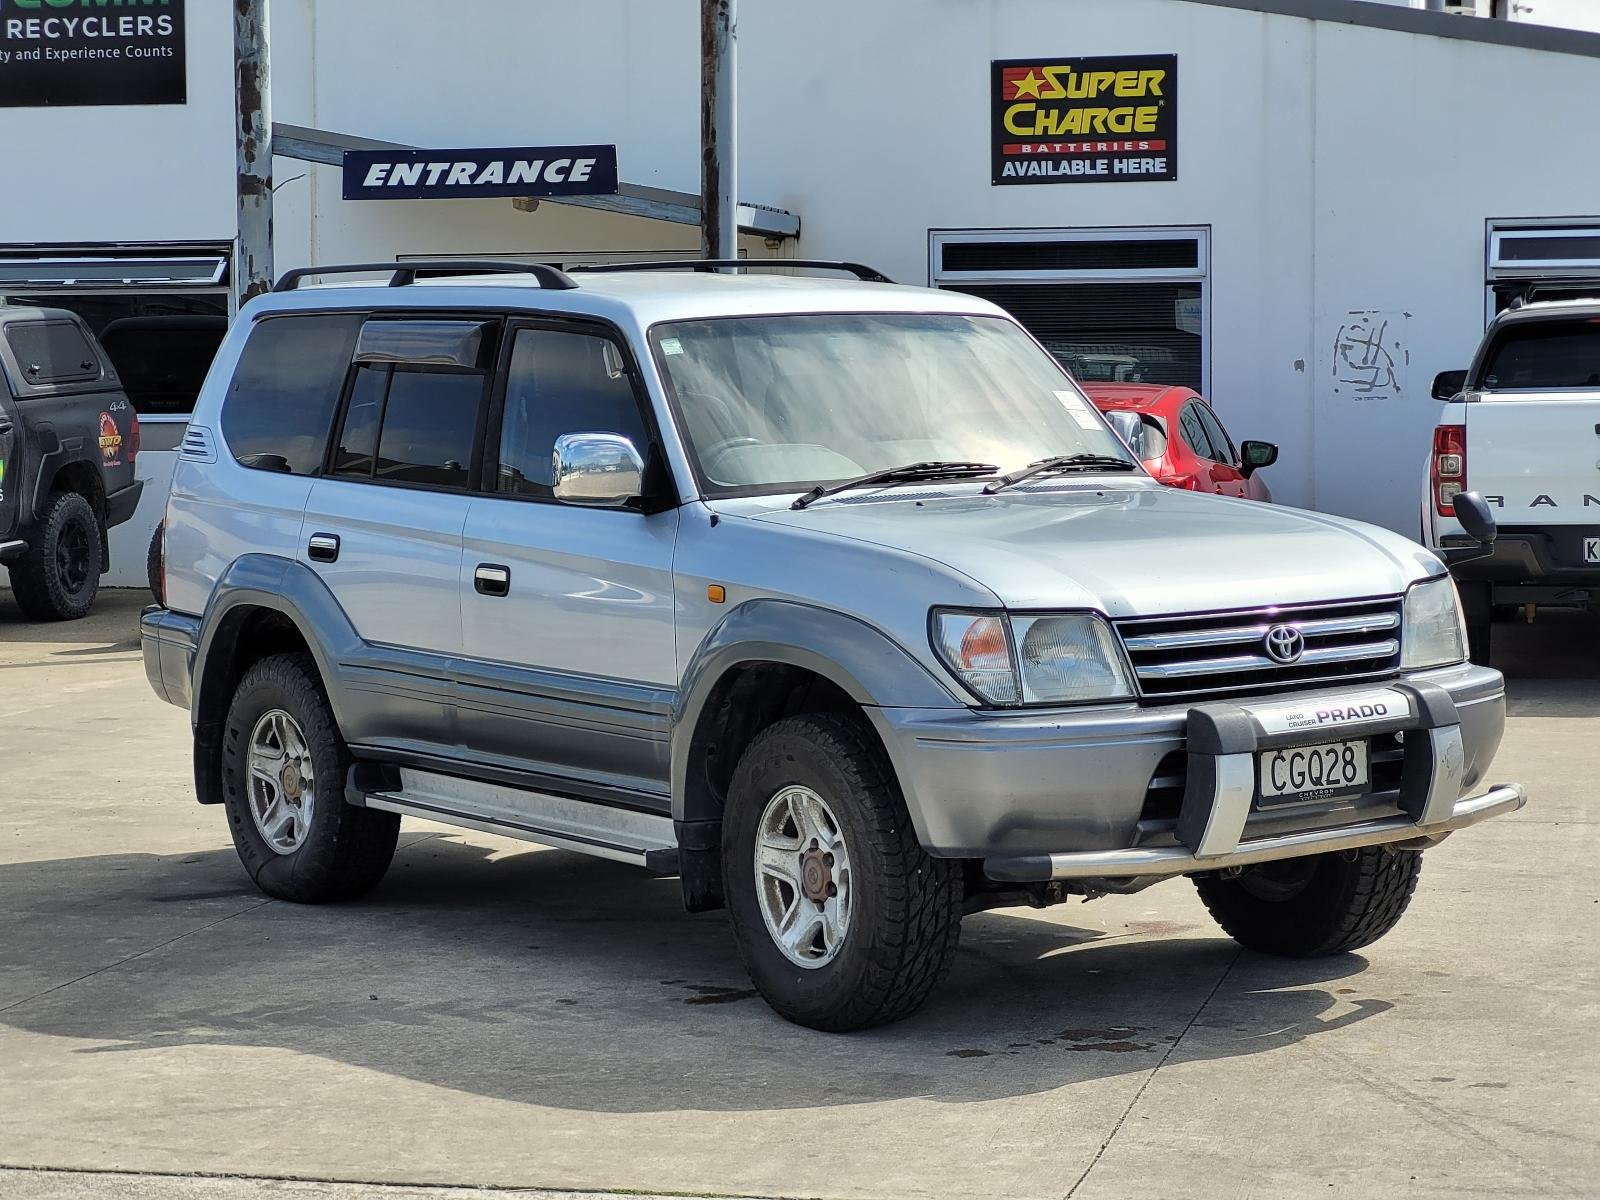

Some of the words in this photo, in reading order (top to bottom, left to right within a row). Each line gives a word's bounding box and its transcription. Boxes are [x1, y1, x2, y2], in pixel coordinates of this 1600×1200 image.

[7, 15, 173, 39] RECYCLERS
[15, 47, 41, 60] and
[46, 47, 121, 61] Experience
[125, 45, 173, 58] Counts
[1040, 65, 1166, 99] SUPER
[1003, 103, 1158, 136] CHARGE
[1021, 141, 1149, 153] BATTERIES
[362, 158, 597, 187] ENTRANCE
[1002, 160, 1108, 177] AVAILABLE
[1113, 157, 1167, 174] HERE
[1286, 713, 1304, 721] LAND
[1316, 703, 1388, 723] PRADO
[1289, 719, 1317, 728] CRUISER
[1272, 747, 1357, 791] CGQ28
[1299, 788, 1334, 798] CHEVRON
